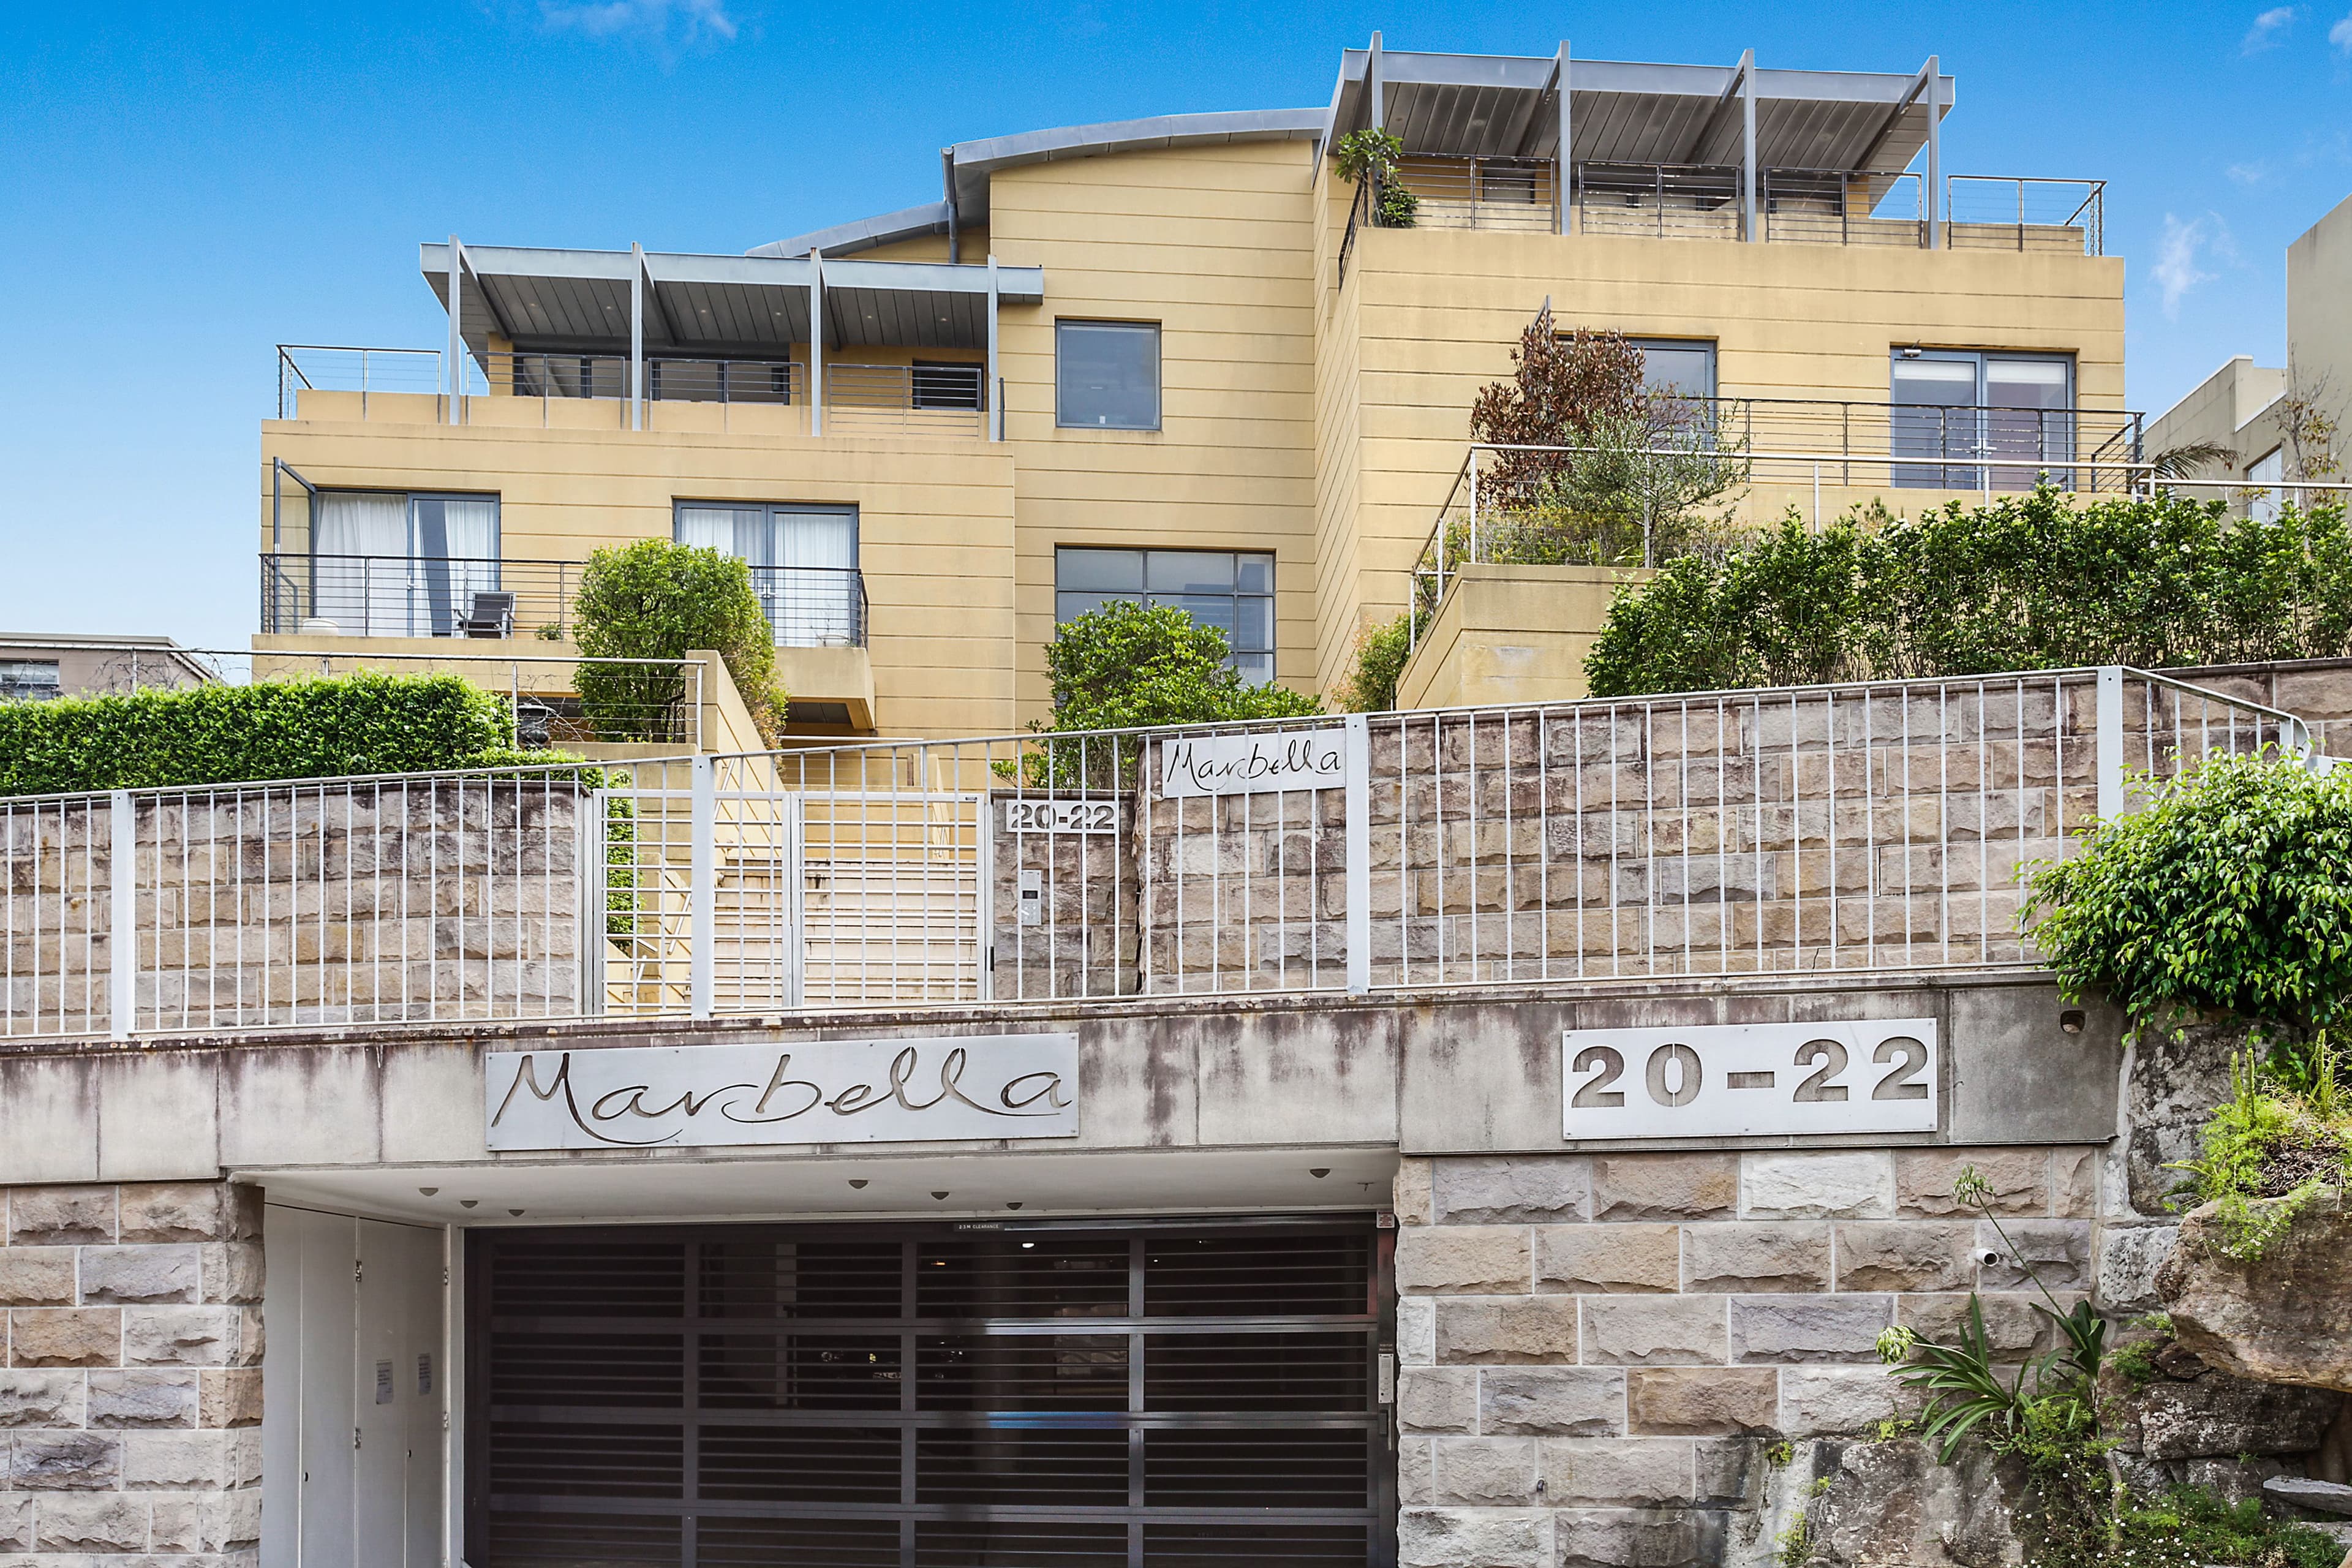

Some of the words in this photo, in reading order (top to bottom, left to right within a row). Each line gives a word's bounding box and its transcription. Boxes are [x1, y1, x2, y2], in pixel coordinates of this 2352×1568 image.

[1167, 739, 1341, 791] Marbella
[1011, 804, 1114, 830] 20-22
[491, 1046, 1073, 1145] Marbella
[1572, 1036, 1929, 1108] 20-22
